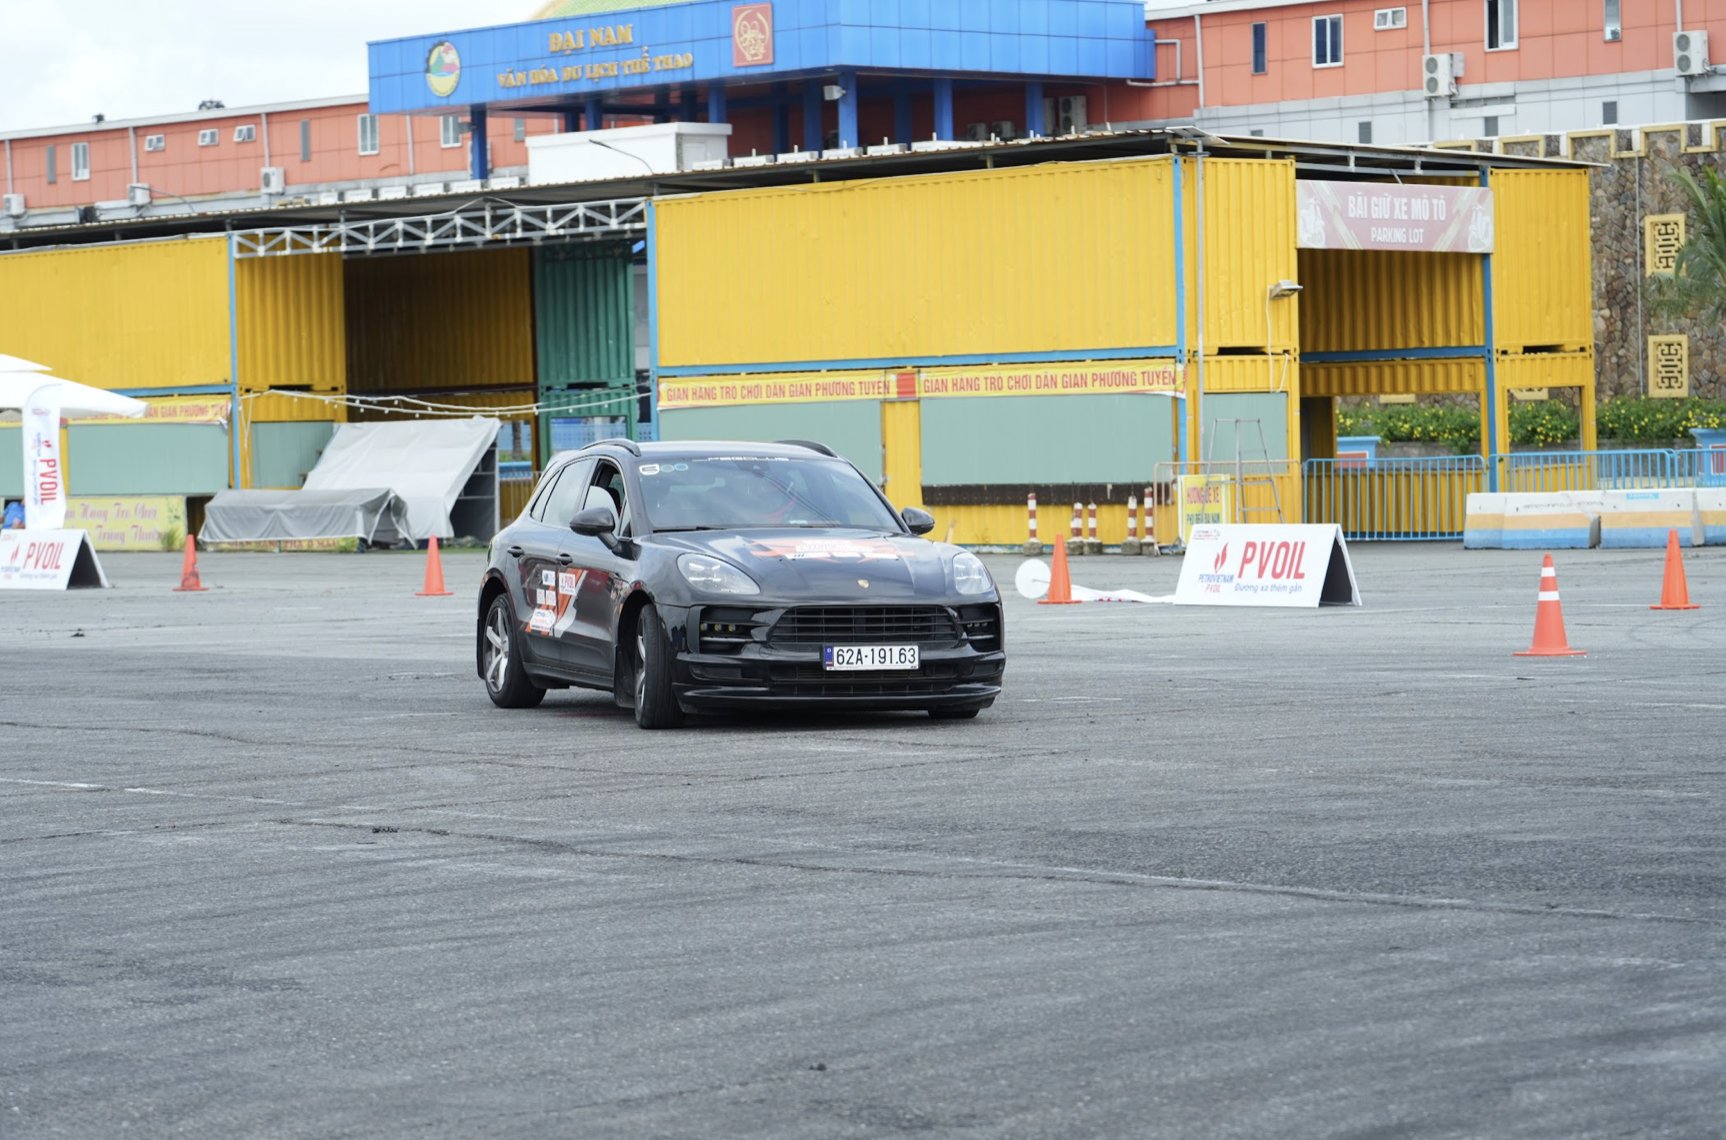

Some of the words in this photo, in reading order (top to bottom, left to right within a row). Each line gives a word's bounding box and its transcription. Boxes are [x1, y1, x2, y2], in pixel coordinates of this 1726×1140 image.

[549, 30, 584, 54] ĐẠI
[589, 24, 633, 47] NAM
[562, 65, 582, 82] DU
[586, 62, 618, 82] LỊCH
[652, 53, 693, 71] THAO
[1348, 192, 1368, 219] BÃI
[1371, 193, 1392, 219] GIỮ
[1394, 196, 1409, 220] XE
[1411, 194, 1430, 221] MÔ
[1432, 195, 1447, 221] TÔ
[1371, 227, 1406, 243] PARKING
[1408, 228, 1424, 244] LOT
[667, 387, 689, 402] GIAN
[789, 382, 812, 398] GIAN
[923, 378, 948, 393] GIAN
[1062, 372, 1087, 388] GIAN
[39, 458, 58, 505] PVOIL
[23, 542, 64, 569] PVOIL
[1238, 541, 1306, 580] PVOIL
[1198, 574, 1235, 584] PETROVIETNAM
[1205, 584, 1222, 593] PVOIL
[1260, 585, 1270, 593] xa
